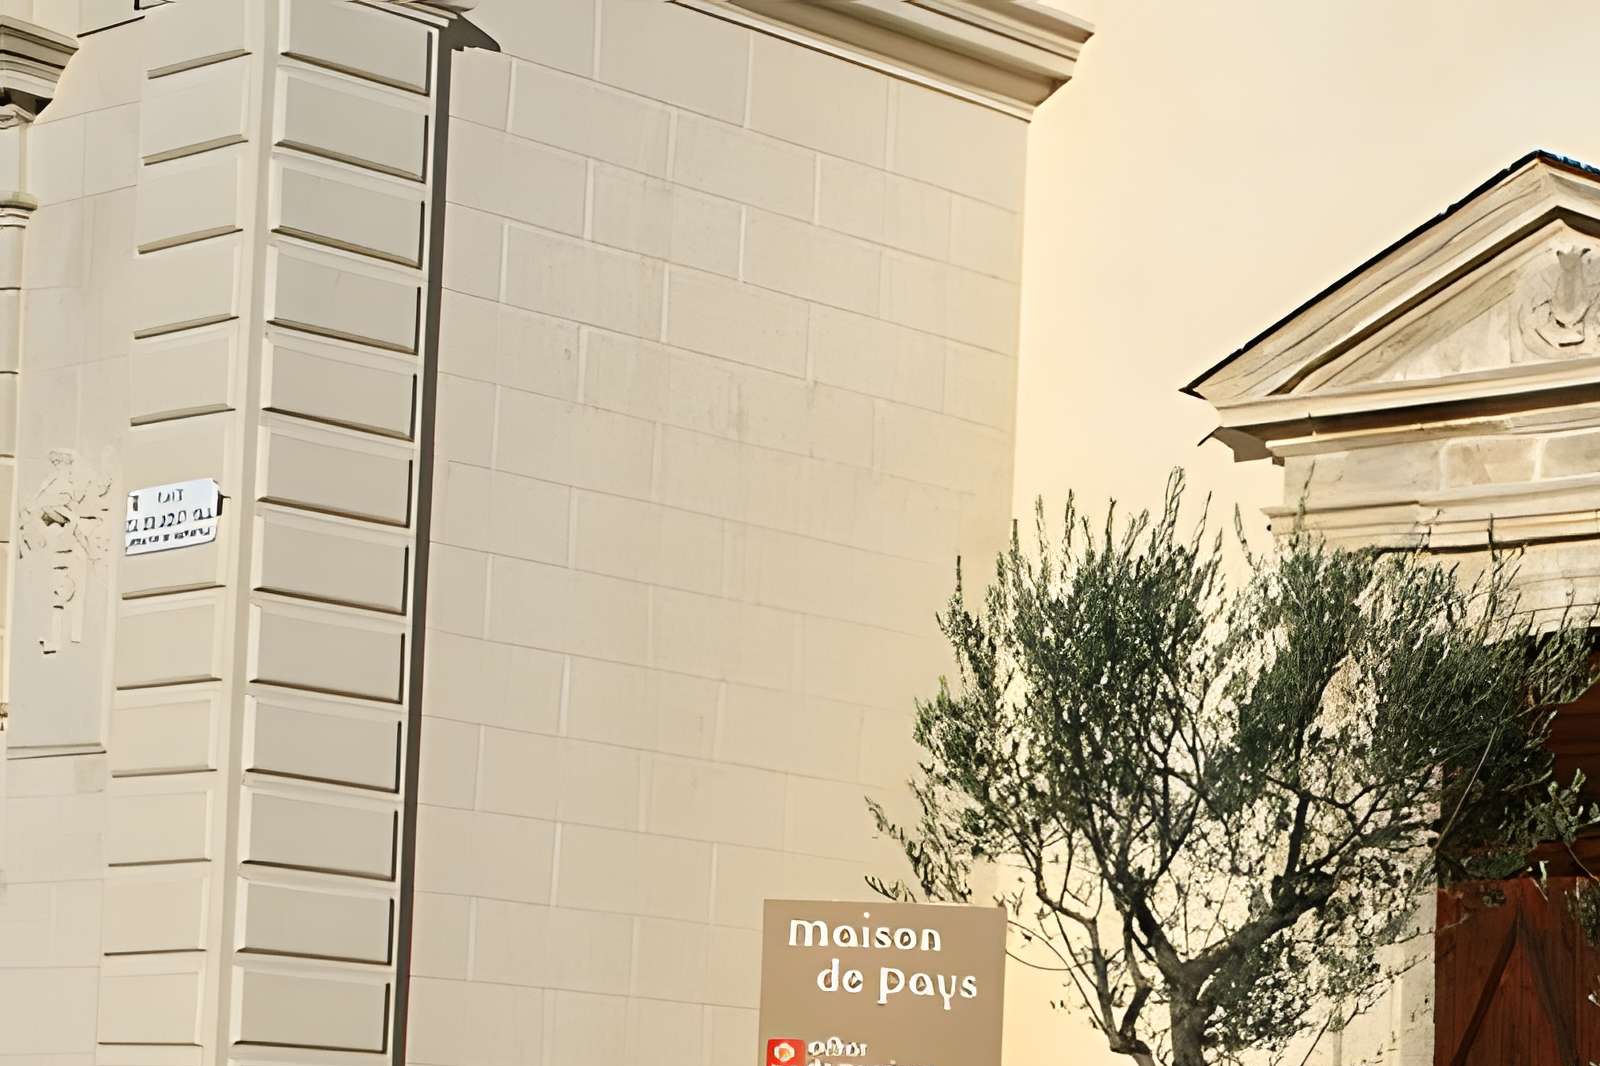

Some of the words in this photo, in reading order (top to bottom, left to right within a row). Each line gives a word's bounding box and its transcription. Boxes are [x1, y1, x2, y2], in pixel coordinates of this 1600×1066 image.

[788, 911, 942, 951] maison
[816, 958, 864, 993] de
[877, 966, 978, 1010] pays
